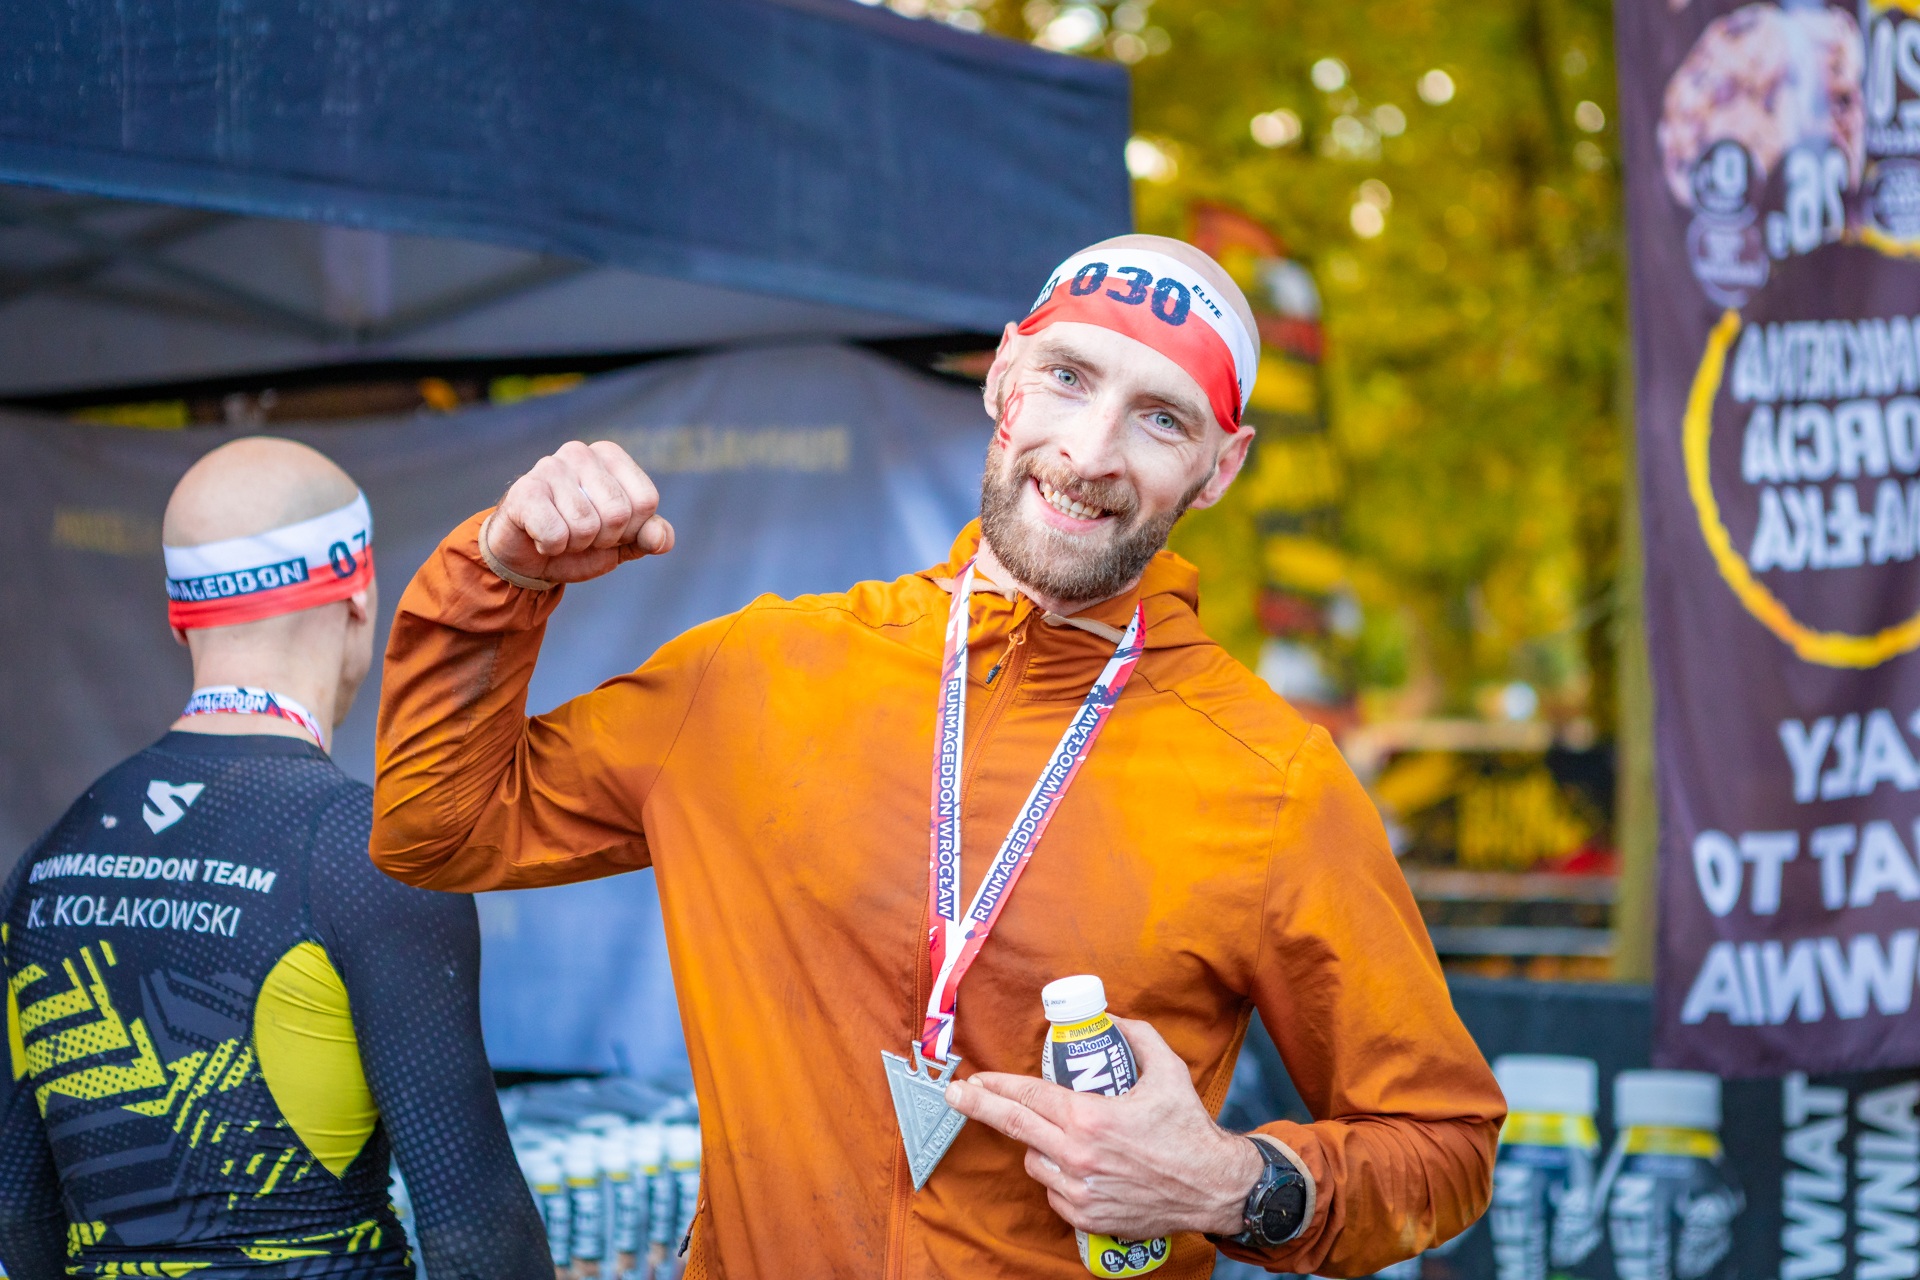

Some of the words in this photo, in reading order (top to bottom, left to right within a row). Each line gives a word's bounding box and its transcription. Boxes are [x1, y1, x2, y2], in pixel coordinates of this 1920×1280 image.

[1069, 262, 1191, 326] 030
[1192, 284, 1222, 319] ELITE
[940, 681, 960, 816] RUNMAGEDDON
[974, 793, 1051, 920] RUNMAGEDDON
[1043, 707, 1099, 793] WROCŁAW
[28, 853, 199, 885] RUNMAGEDDON
[202, 859, 277, 893] TEAM
[938, 821, 953, 918] WROCŁAW
[27, 898, 46, 929] K.
[53, 894, 241, 938] KOŁAKOWSKI
[1068, 1035, 1112, 1055] Bakoma
[1105, 1251, 1123, 1264] 0%
